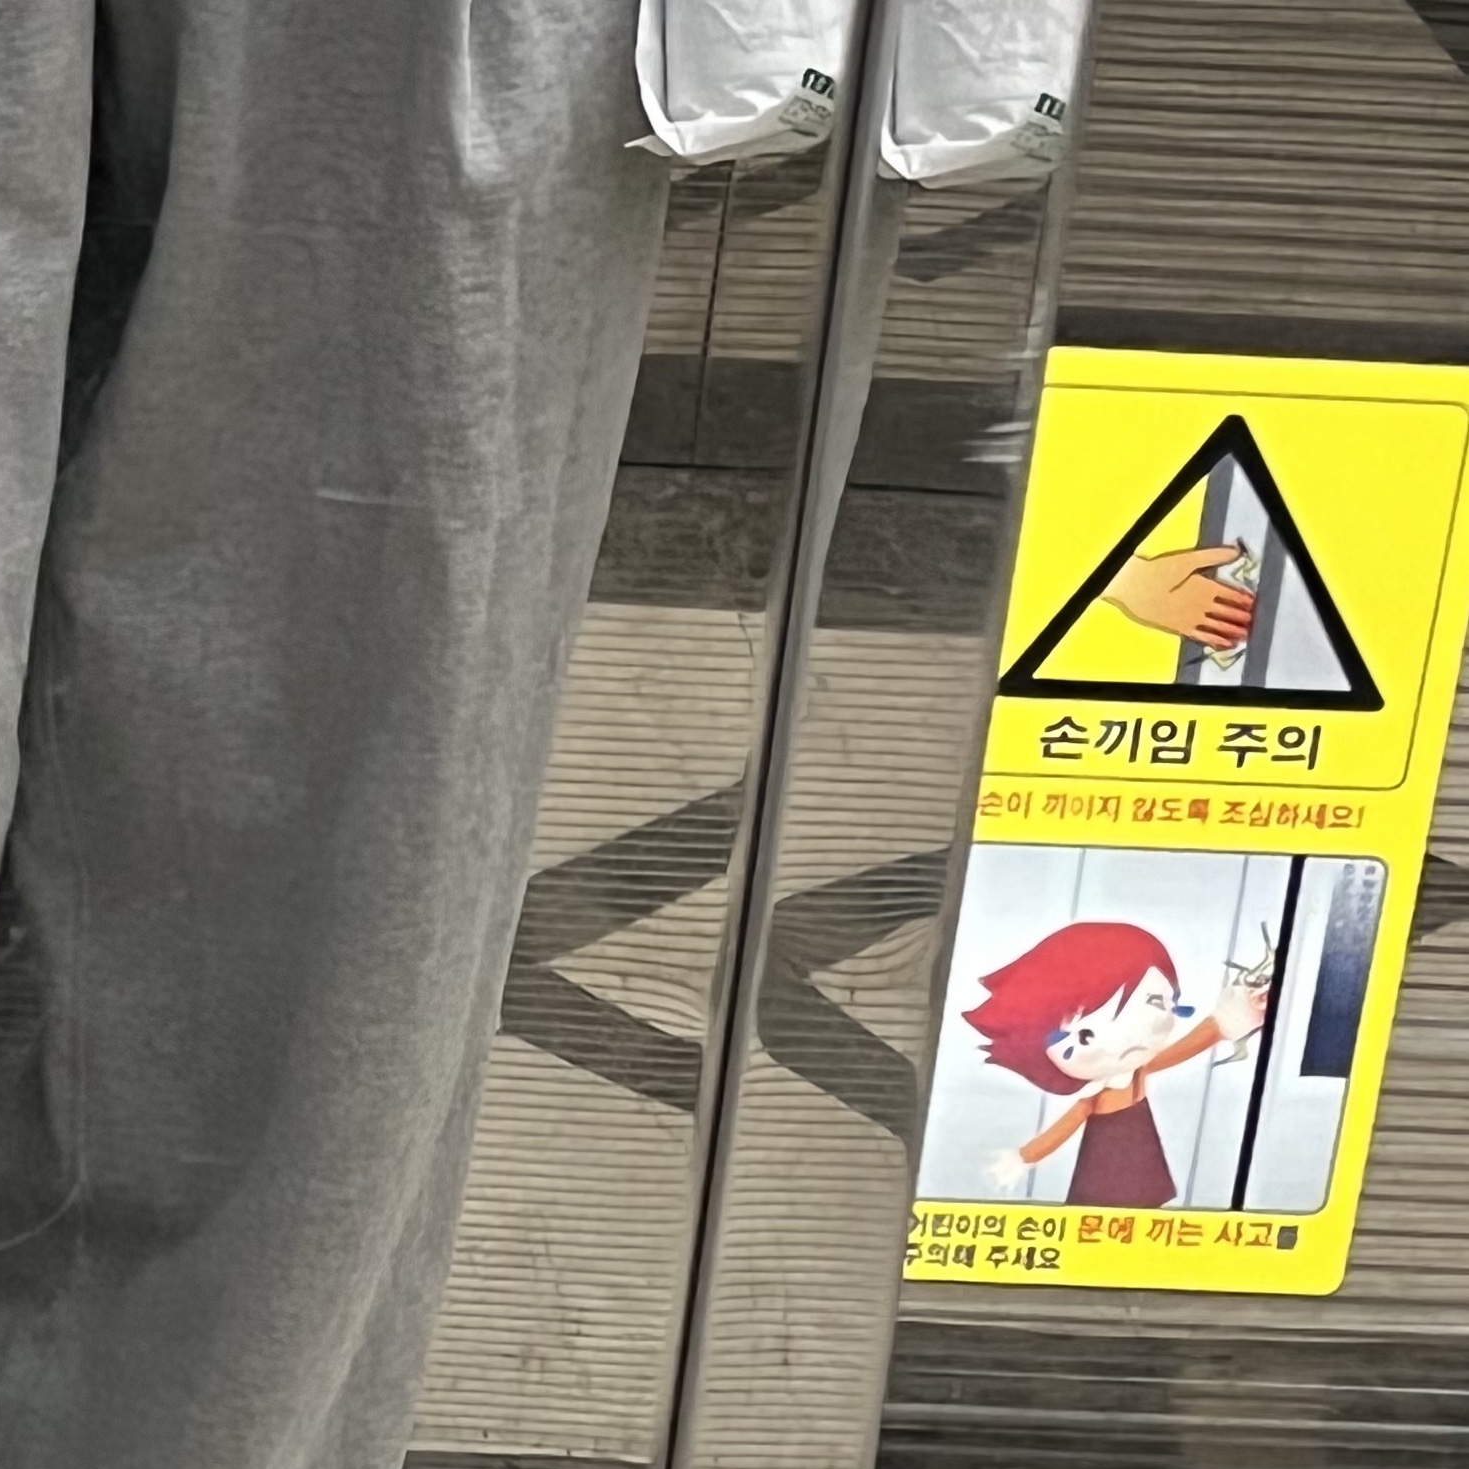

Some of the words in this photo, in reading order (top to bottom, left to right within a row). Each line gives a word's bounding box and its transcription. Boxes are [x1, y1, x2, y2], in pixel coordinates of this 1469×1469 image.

[1040, 716, 1196, 764] 손끼임
[1217, 723, 1321, 770] 주의
[979, 791, 1032, 818] 손이
[1043, 794, 1121, 822] 끼이지
[1017, 1217, 1066, 1241] 손이
[1078, 1215, 1135, 1244] 문에
[1146, 1218, 1203, 1246] 끼는
[1214, 1221, 1298, 1250] 사고
[986, 1246, 1060, 1270] 주세요
